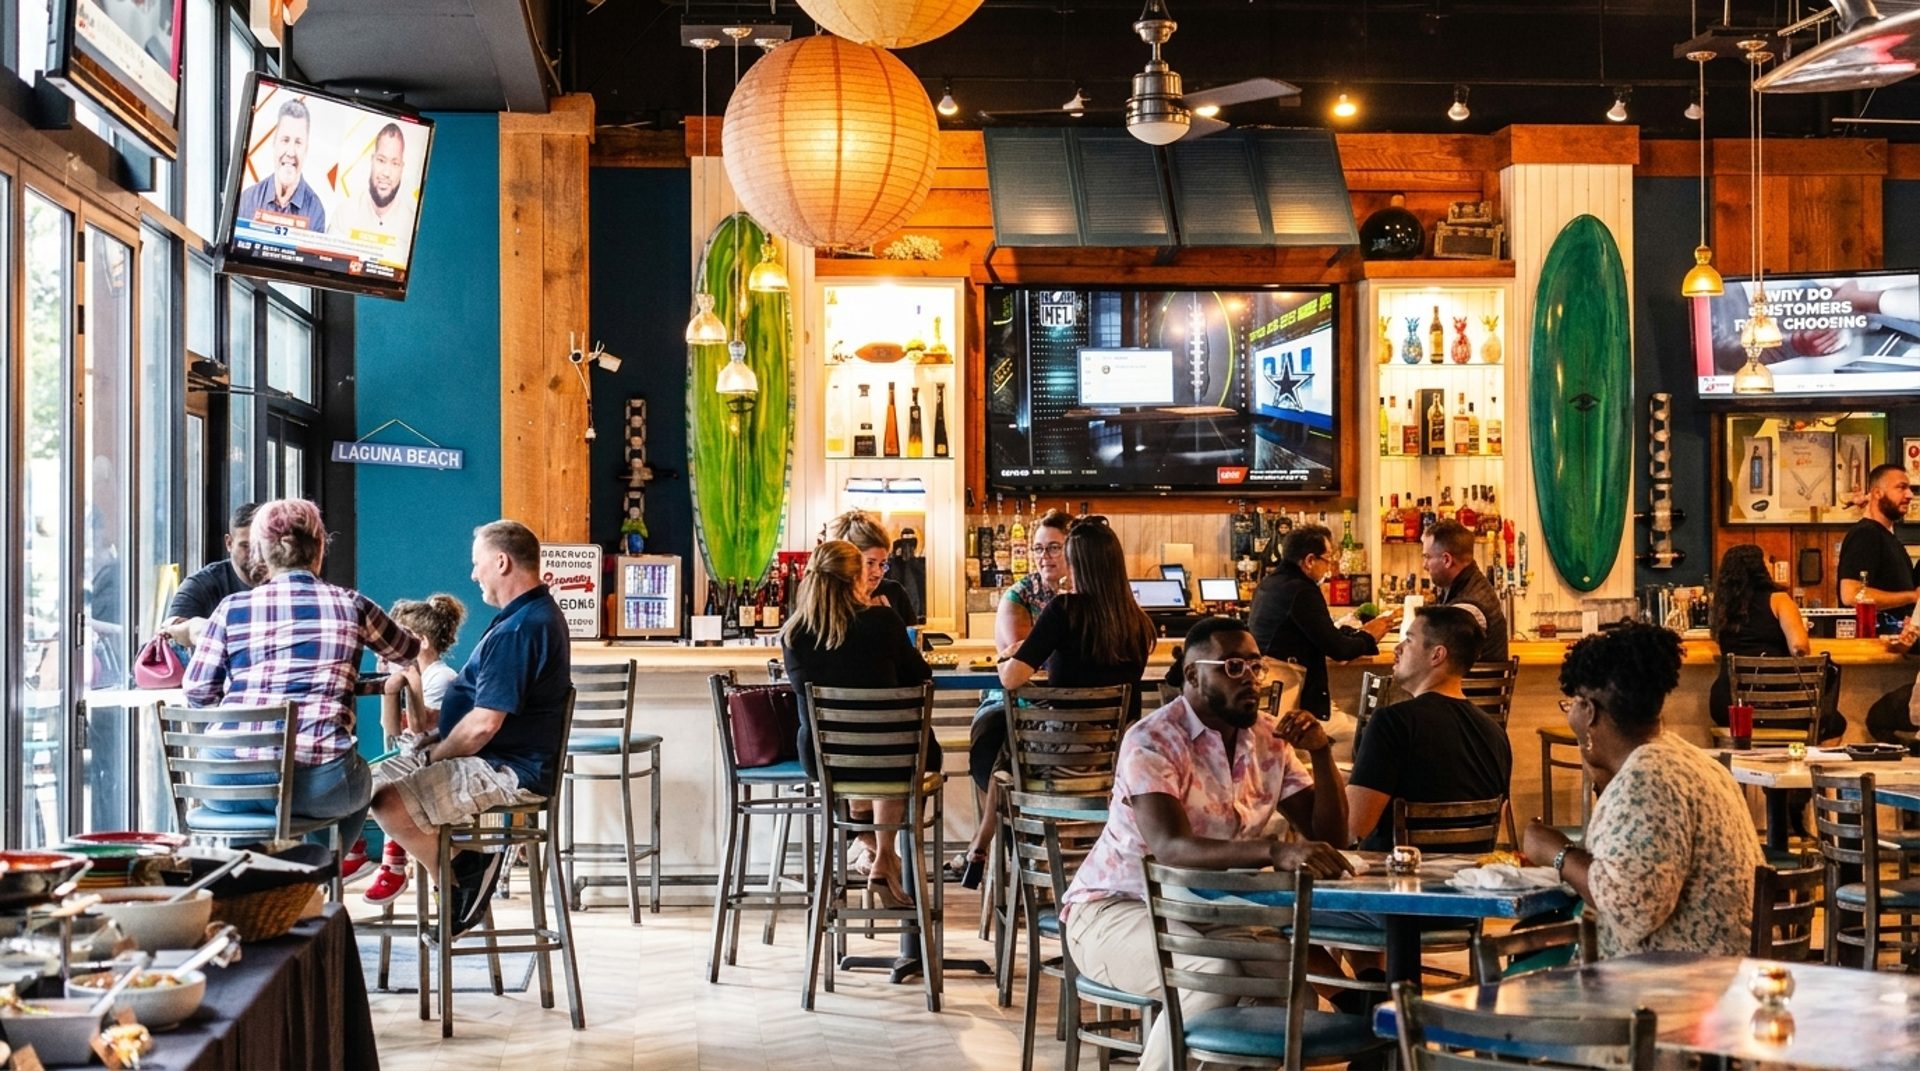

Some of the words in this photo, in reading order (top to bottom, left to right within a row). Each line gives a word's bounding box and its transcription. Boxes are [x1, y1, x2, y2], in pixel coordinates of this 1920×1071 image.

[1807, 287, 1833, 301] DO
[338, 444, 402, 463] LAGUNA
[406, 448, 460, 467] BEACH
